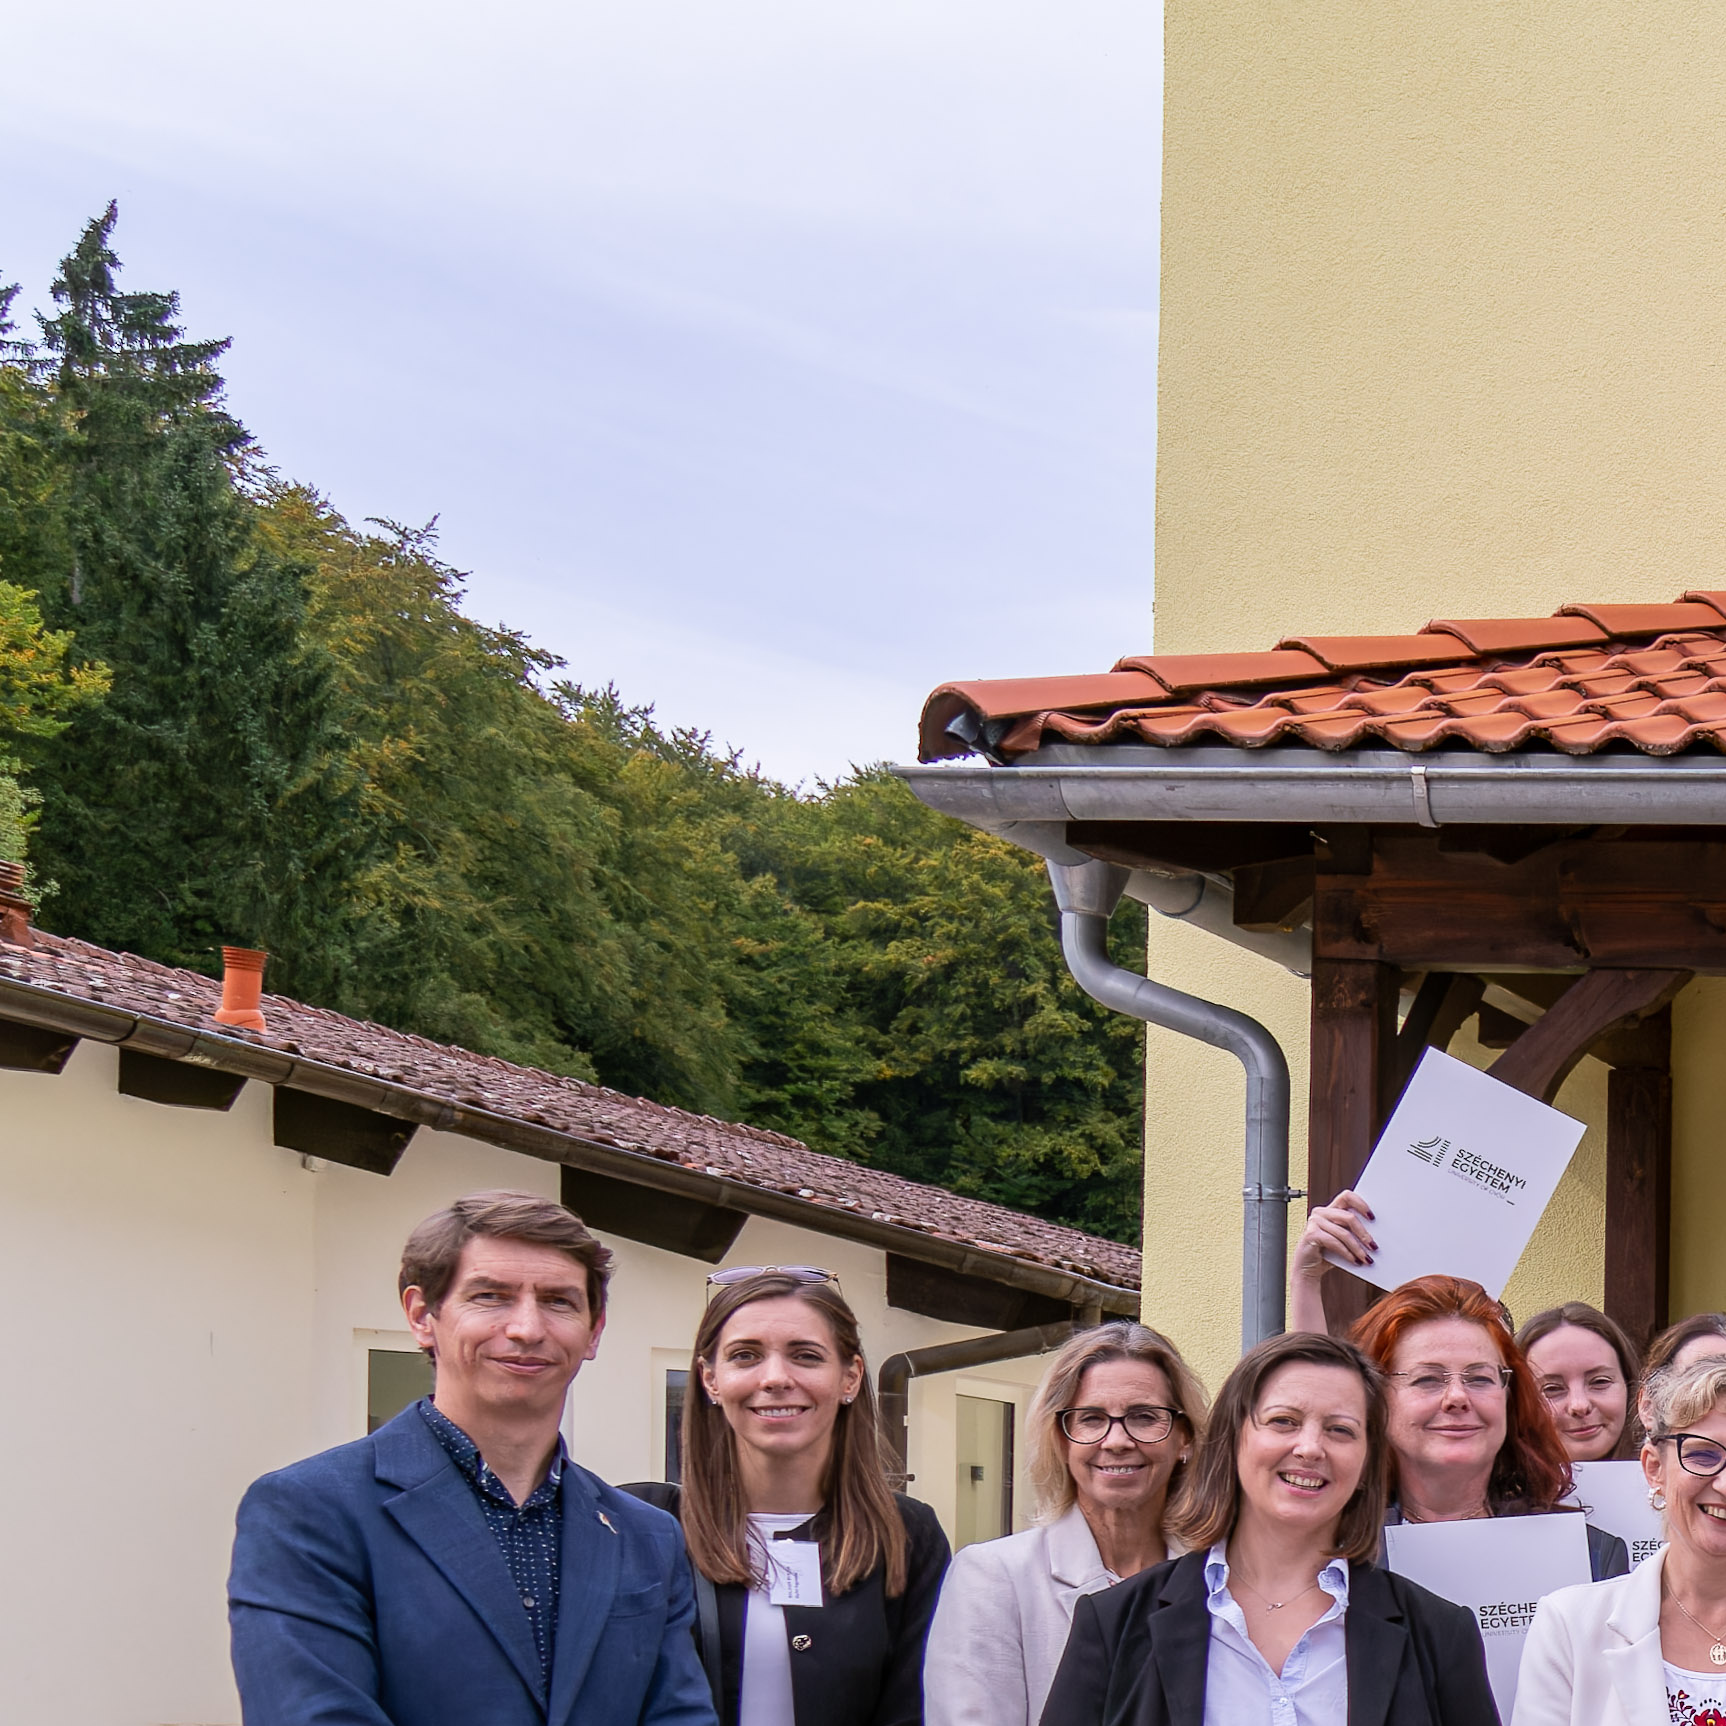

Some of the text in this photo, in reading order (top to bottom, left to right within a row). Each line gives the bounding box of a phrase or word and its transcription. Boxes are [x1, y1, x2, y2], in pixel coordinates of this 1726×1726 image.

[1450, 1161, 1511, 1194] EGYETEM
[1457, 1148, 1527, 1190] SZÉCHENYI
[1479, 1601, 1537, 1616] SZÉCHE
